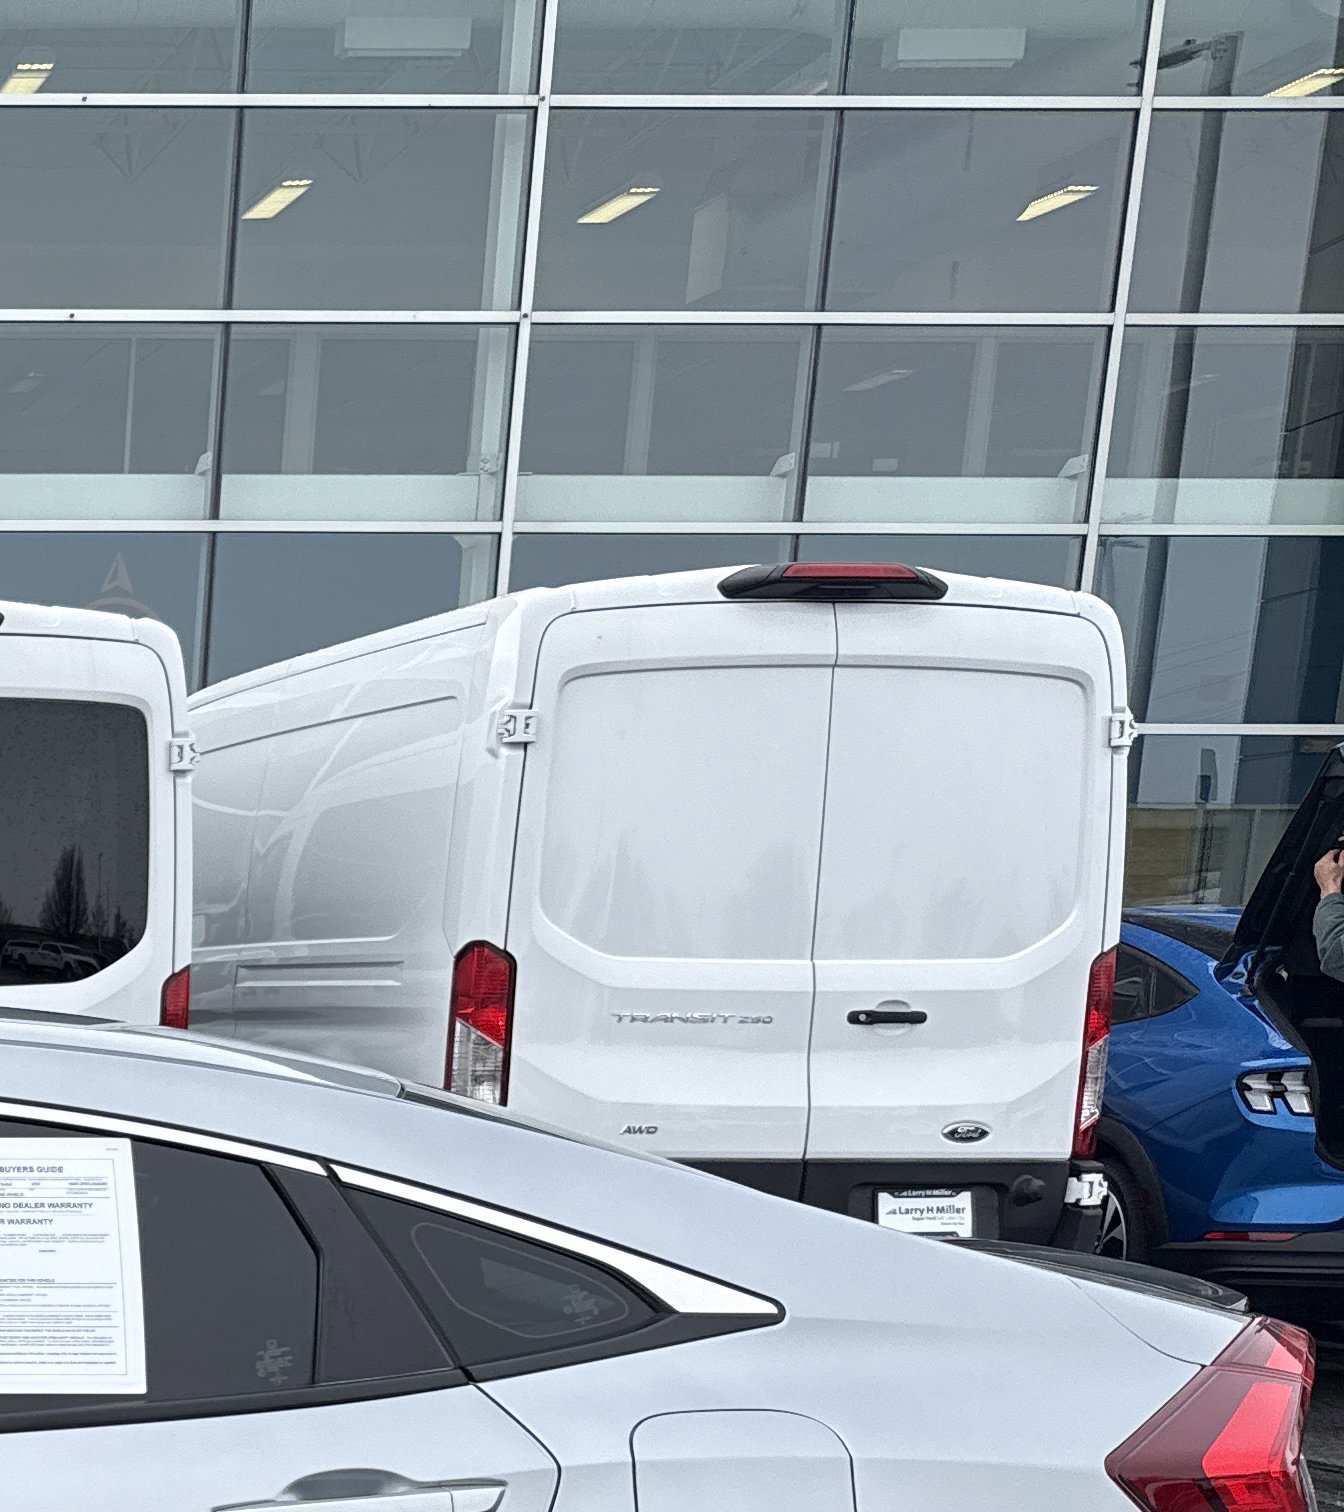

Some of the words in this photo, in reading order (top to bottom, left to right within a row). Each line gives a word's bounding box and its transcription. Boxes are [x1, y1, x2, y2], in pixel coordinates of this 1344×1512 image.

[611, 1012, 736, 1024] TRANSIT
[619, 1124, 659, 1136] AWD
[37, 1166, 64, 1174] GUIDE
[898, 1206, 925, 1216] Larry
[926, 1206, 934, 1214] H
[935, 1205, 966, 1214] Miller
[7, 1218, 54, 1226] WARRANTY
